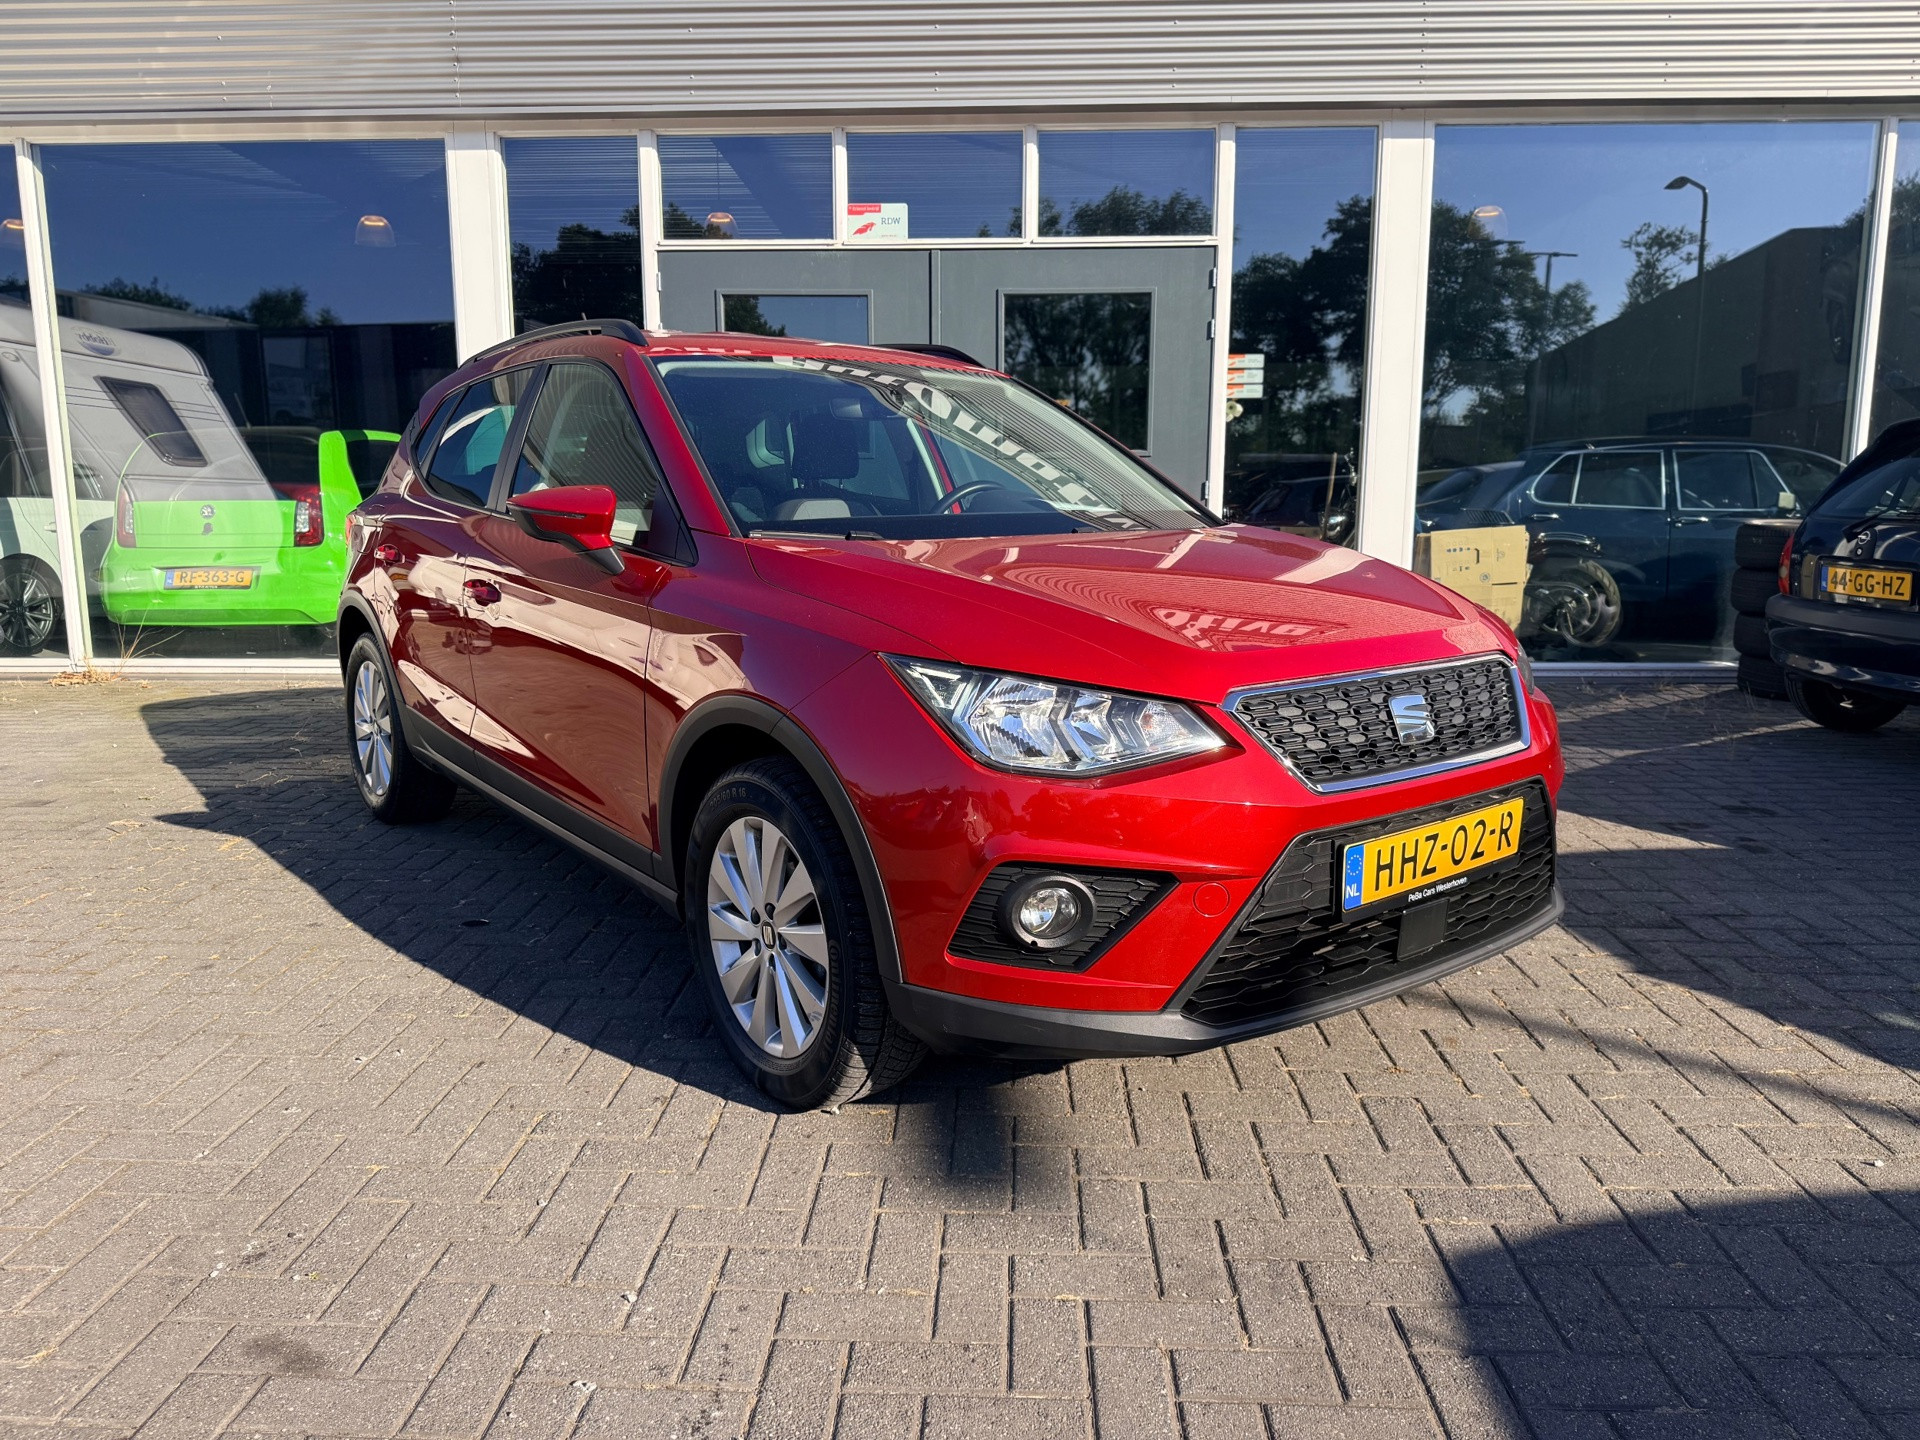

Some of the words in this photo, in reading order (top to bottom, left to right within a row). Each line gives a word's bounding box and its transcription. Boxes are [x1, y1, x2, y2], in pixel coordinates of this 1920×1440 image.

[881, 217, 901, 225] RDW
[179, 571, 245, 583] RF-363-G
[1831, 571, 1906, 596] 44-GG-HZ
[1375, 811, 1513, 891] HHZ-02-R
[1346, 883, 1360, 899] NL
[1408, 891, 1422, 902] PeBa
[1423, 888, 1435, 897] Cars
[1436, 876, 1467, 892] Westerhoven
